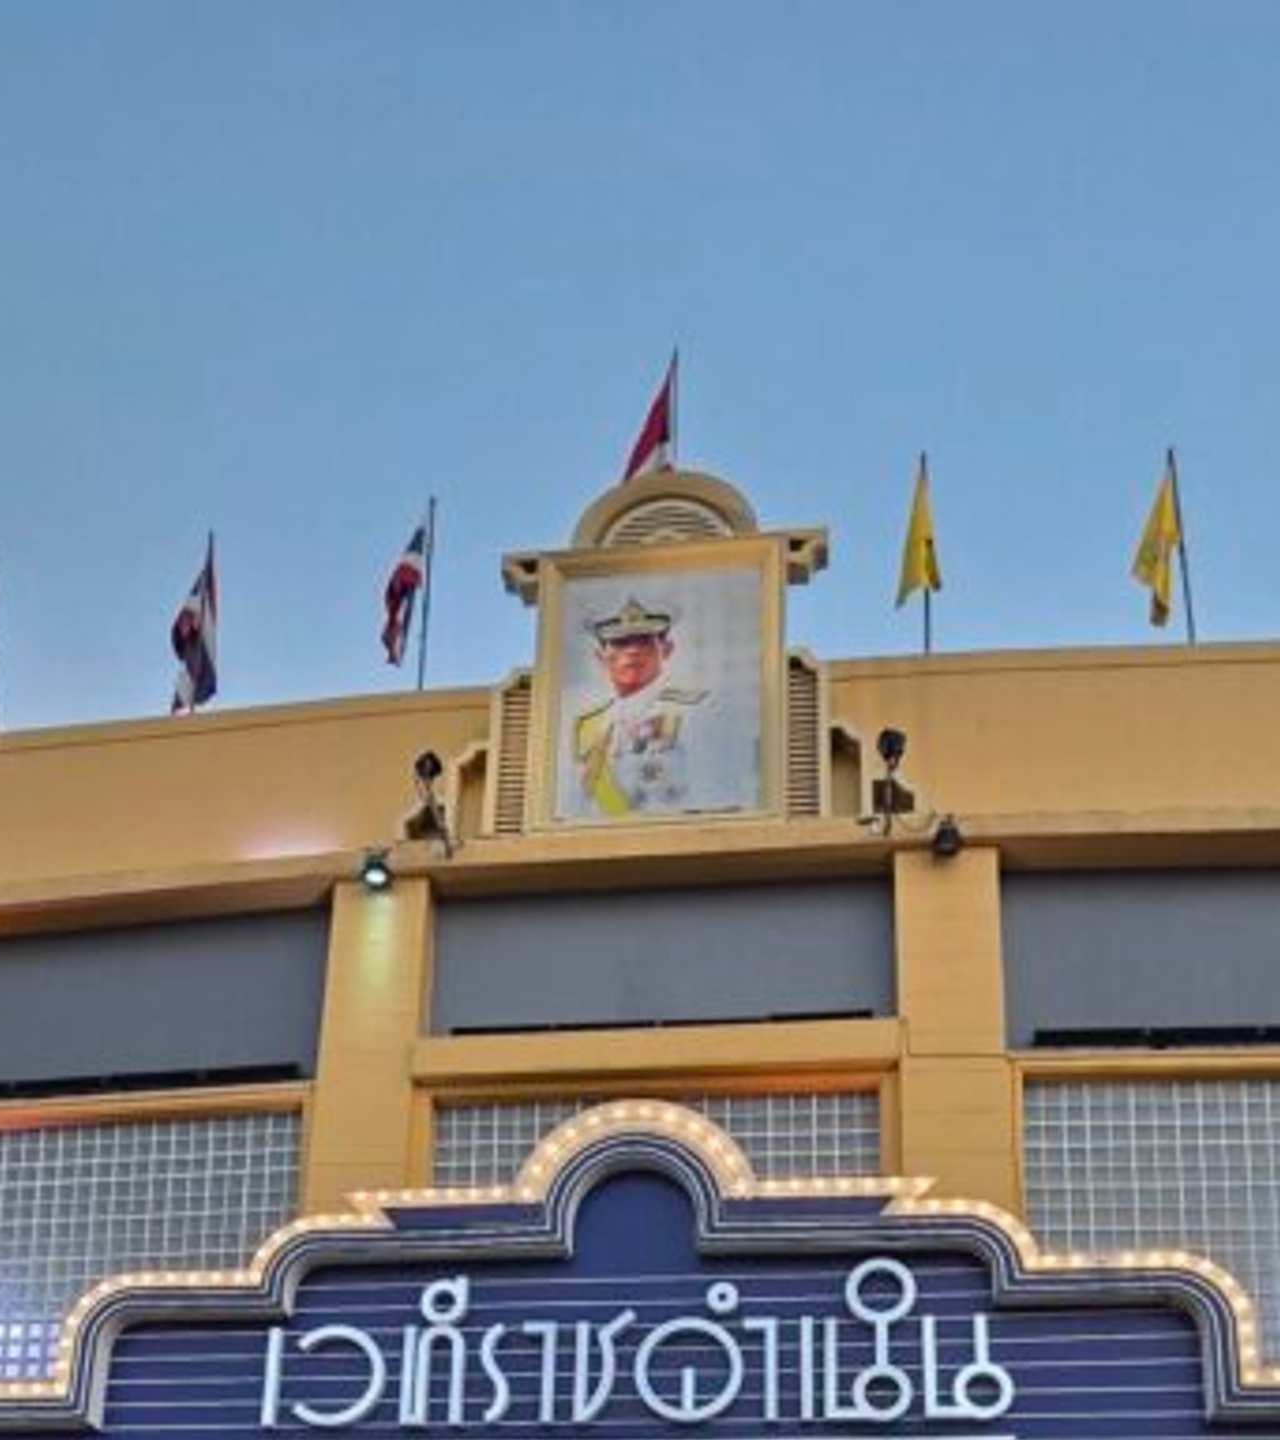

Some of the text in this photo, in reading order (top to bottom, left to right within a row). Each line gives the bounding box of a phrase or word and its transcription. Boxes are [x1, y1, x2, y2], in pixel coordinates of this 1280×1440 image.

[260, 1258, 1015, 1428] เวทีราชดำเนิน
